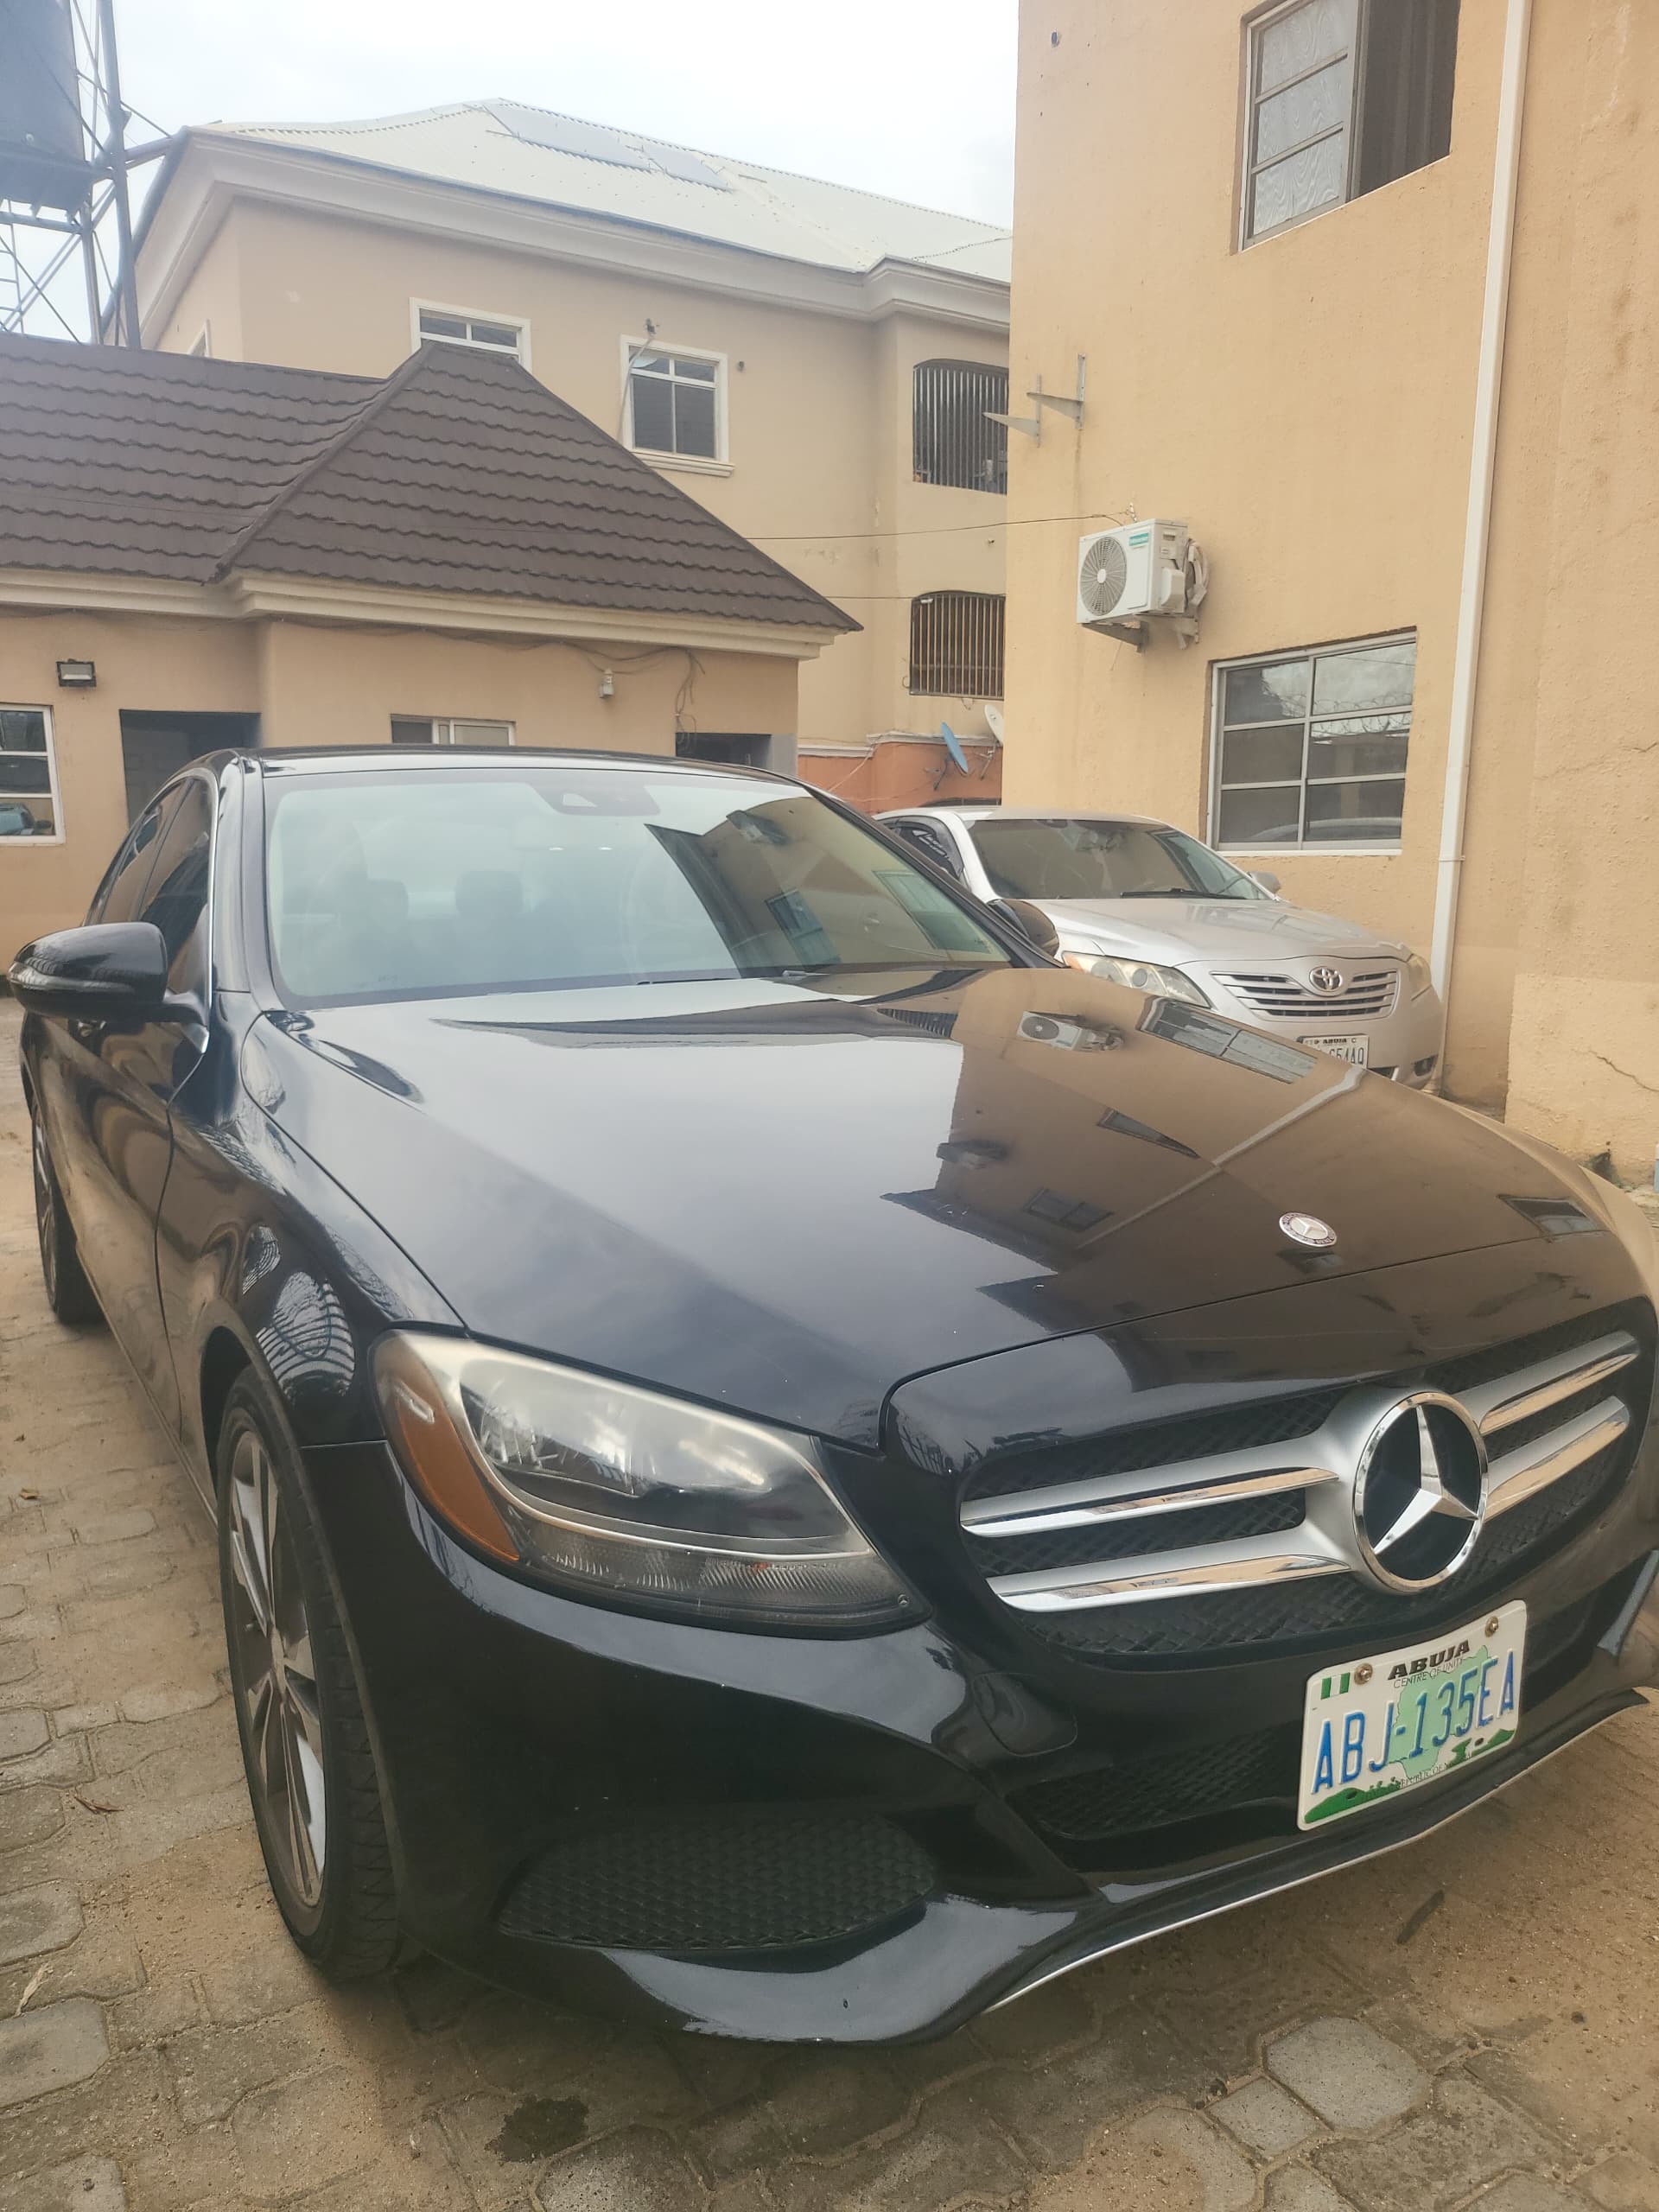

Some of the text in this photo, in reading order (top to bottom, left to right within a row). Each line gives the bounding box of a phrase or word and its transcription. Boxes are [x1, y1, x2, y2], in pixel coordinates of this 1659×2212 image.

[1387, 1639, 1471, 1681] ABUJA
[1393, 1657, 1465, 1688] CENTRE OF UNITY
[1311, 1648, 1515, 1795] ABJ-135EA
